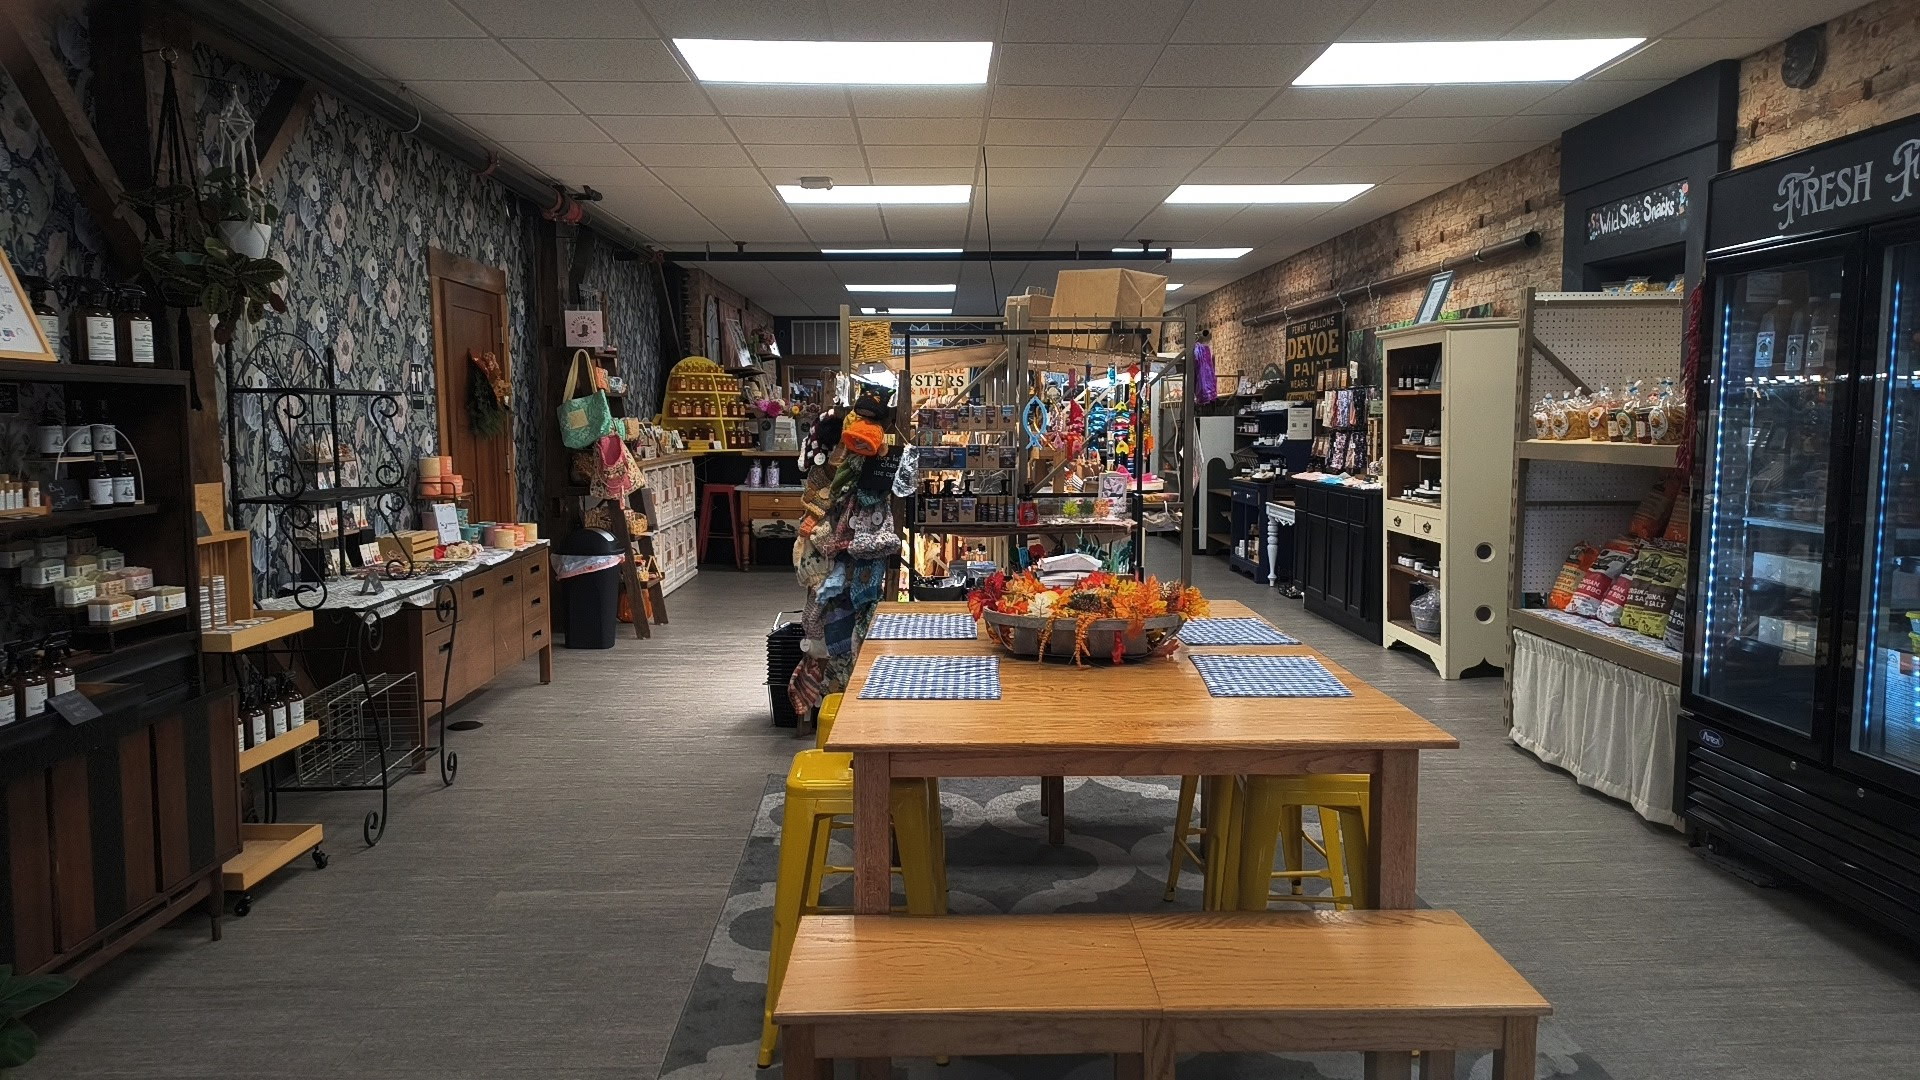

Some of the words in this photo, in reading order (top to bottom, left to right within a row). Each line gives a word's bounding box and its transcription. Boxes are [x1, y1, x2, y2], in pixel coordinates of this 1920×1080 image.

[1773, 161, 1873, 230] FRESH
[1599, 210, 1620, 234] Wild
[1620, 203, 1640, 228] Side
[1643, 195, 1675, 222] Snacks
[1310, 316, 1335, 330] GALLONS
[1287, 329, 1339, 361] DEVOE
[1294, 359, 1332, 377] PAIT
